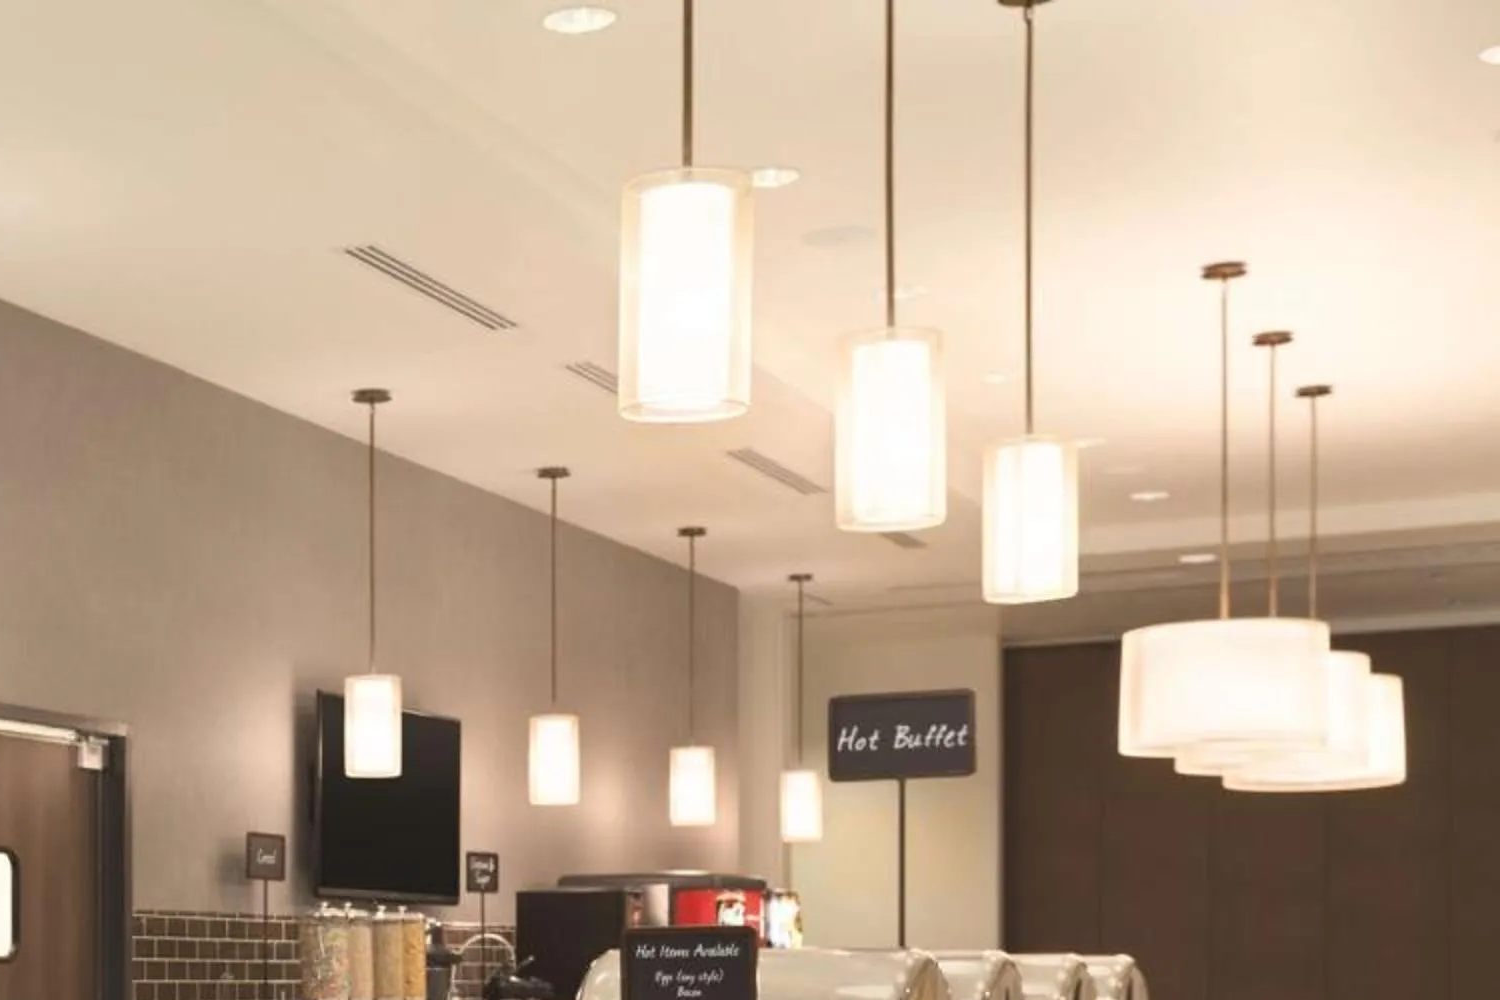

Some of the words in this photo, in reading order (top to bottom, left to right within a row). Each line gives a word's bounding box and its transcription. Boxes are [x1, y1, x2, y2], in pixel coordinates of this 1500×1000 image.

[837, 725, 880, 752] Hot
[893, 723, 968, 750] Buffet
[635, 943, 656, 959] Hot
